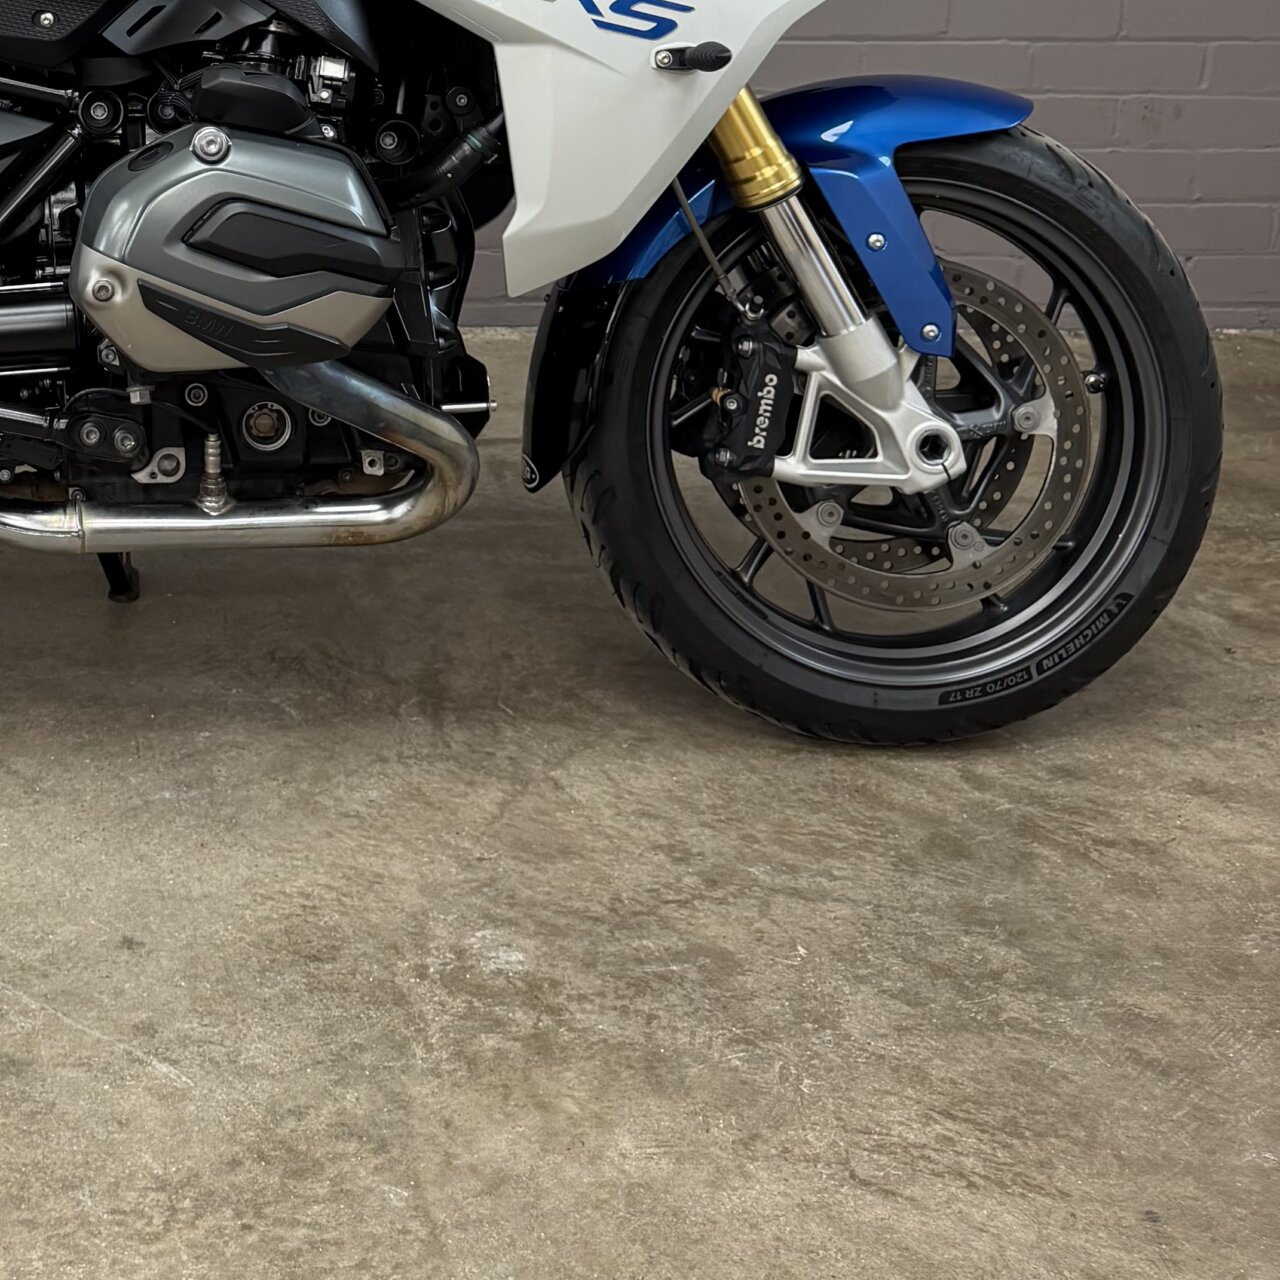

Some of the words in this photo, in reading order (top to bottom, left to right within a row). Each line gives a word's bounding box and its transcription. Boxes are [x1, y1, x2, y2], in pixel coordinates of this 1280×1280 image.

[184, 310, 234, 338] BMW
[747, 374, 778, 449] brembo
[1042, 610, 1111, 670] MICHELIN
[964, 687, 982, 701] ZR
[986, 669, 1029, 693] 120/70
[948, 691, 962, 702] 17
